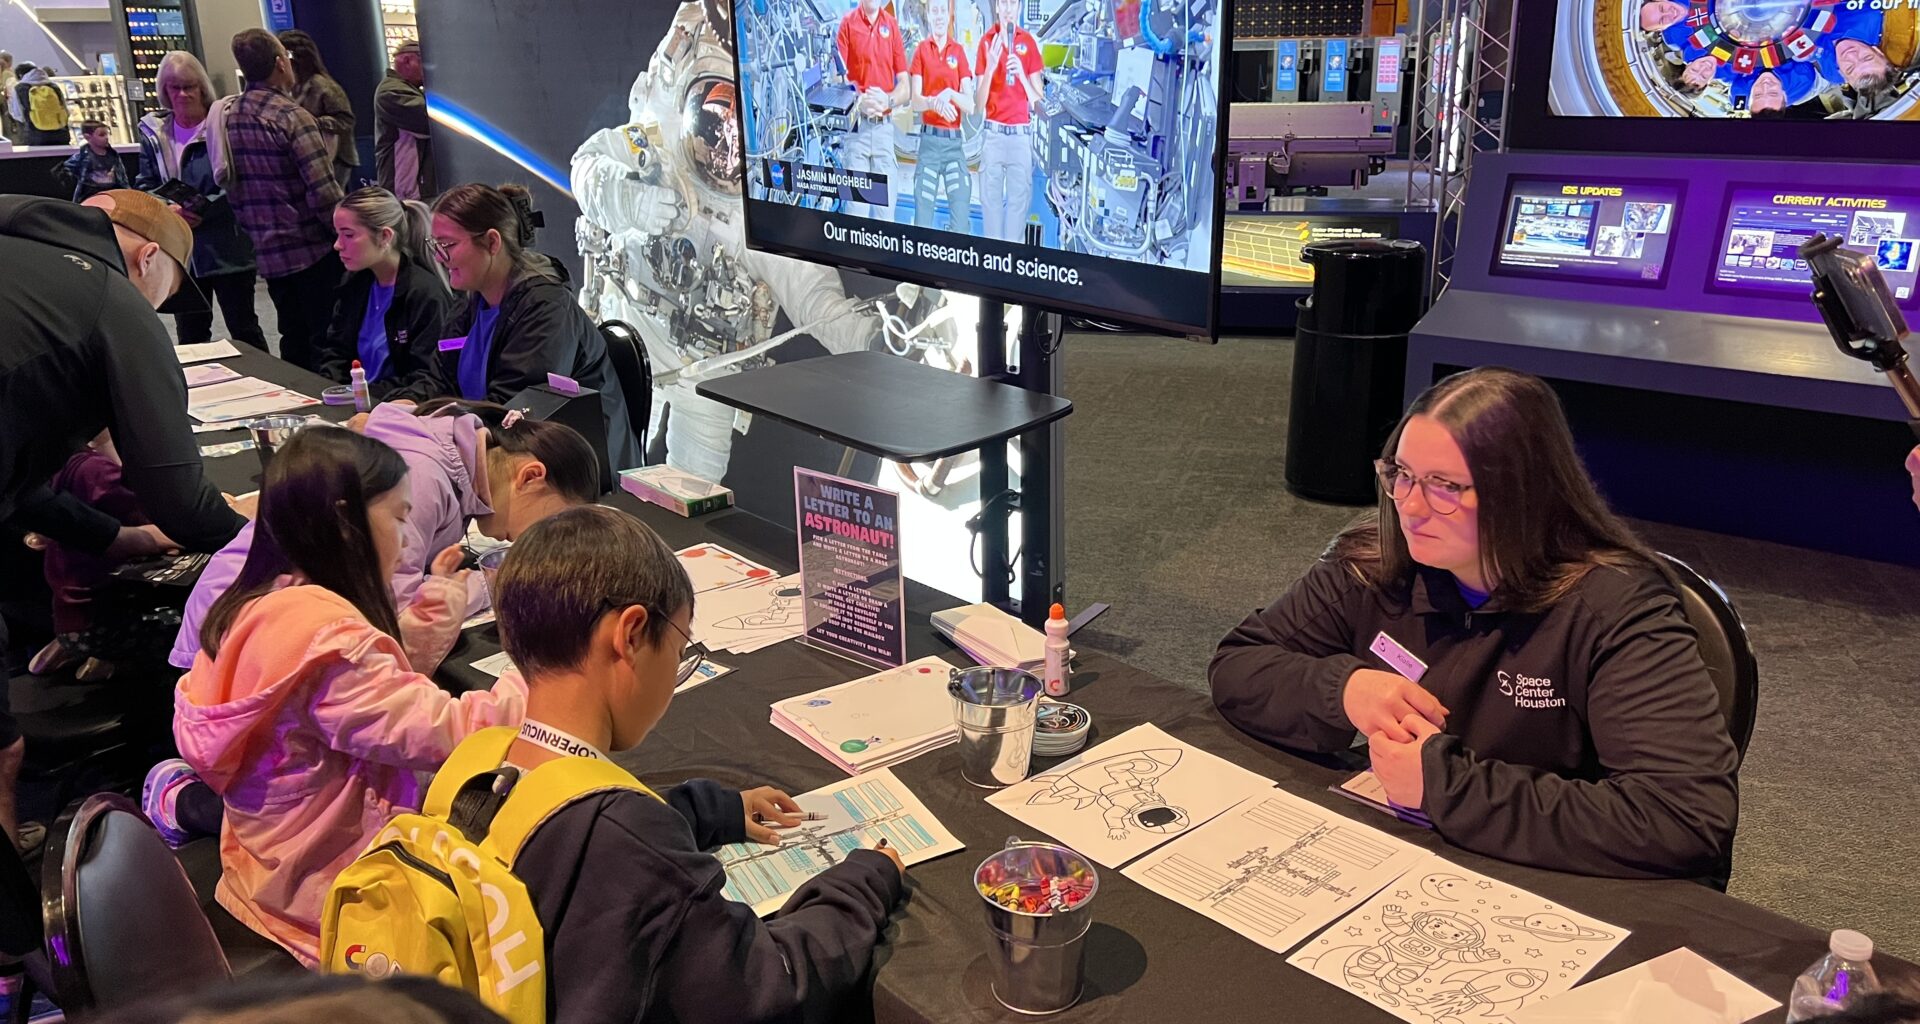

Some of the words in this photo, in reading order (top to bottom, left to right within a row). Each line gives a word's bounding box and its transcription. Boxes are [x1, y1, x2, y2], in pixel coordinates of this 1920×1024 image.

[1846, 0, 1866, 10] of
[1870, 0, 1902, 10] our
[796, 169, 827, 183] JASMIN
[828, 173, 872, 190] MOGHBELI
[810, 184, 838, 194] ASTRONAUT
[1562, 185, 1578, 195] ISS
[1580, 186, 1623, 197] UPDATES
[1772, 194, 1824, 206] CURRENT
[1826, 197, 1887, 209] ACTIVITIES
[823, 221, 848, 243] Our
[850, 227, 899, 252] mission
[902, 234, 914, 255] is
[917, 241, 979, 267] research
[983, 252, 1012, 274] and
[1016, 258, 1083, 286] science.
[820, 484, 860, 507] WRITE
[864, 495, 874, 511] A
[804, 495, 850, 520] LETTER
[853, 508, 870, 526] TO
[874, 514, 893, 531] AN
[805, 512, 894, 549] ASTRONAUT!
[812, 534, 824, 542] PICK
[828, 538, 846, 548] LETTER
[846, 543, 860, 552] FROM
[862, 548, 871, 556] THE
[872, 550, 888, 560] TABLE
[822, 544, 838, 553] WRITE
[844, 550, 861, 560] LETTER
[842, 590, 860, 600] LETTER
[853, 586, 871, 596] LETTER
[826, 630, 838, 639] YOUR
[838, 634, 866, 648] CREATIVITY
[863, 629, 885, 641] MAILBOX
[1515, 673, 1551, 688] Space
[1515, 684, 1554, 698] Center
[1515, 695, 1566, 709] Houston
